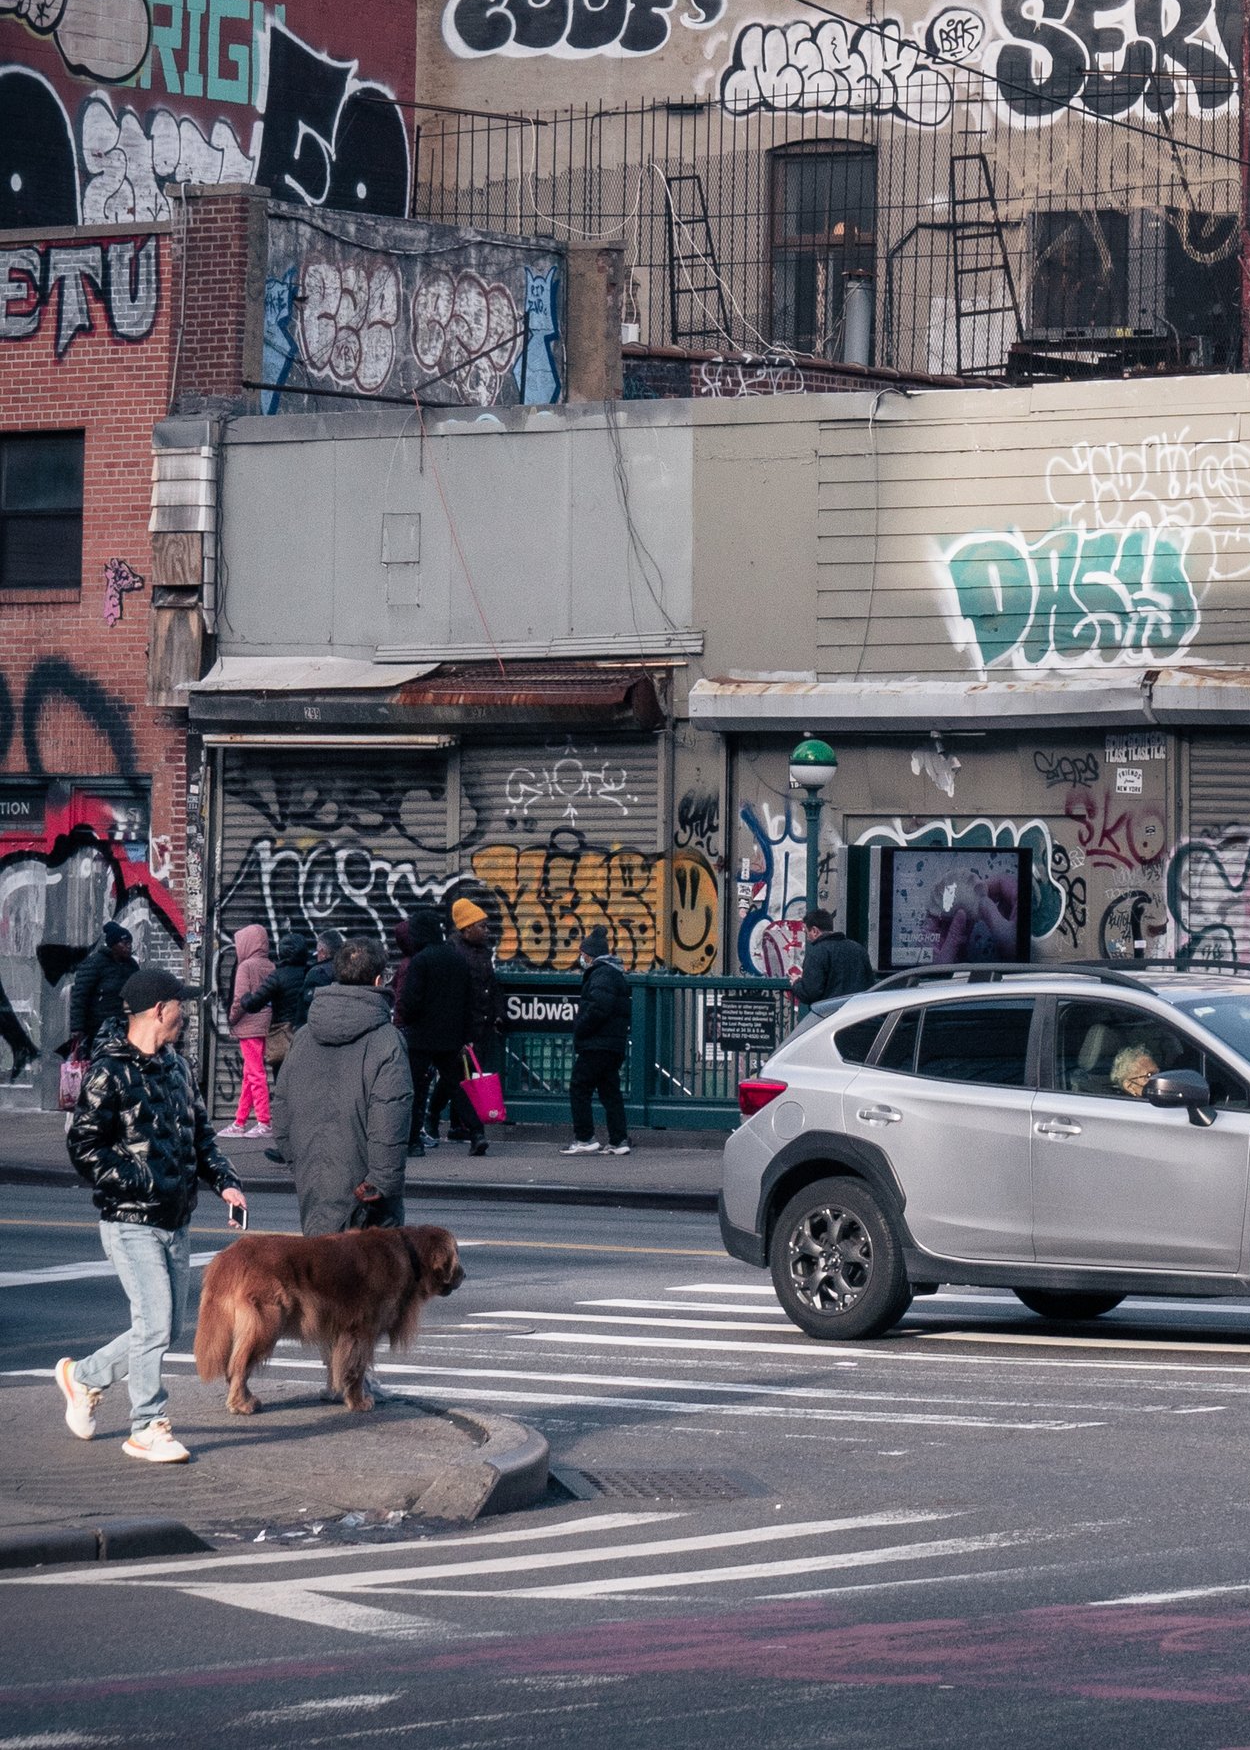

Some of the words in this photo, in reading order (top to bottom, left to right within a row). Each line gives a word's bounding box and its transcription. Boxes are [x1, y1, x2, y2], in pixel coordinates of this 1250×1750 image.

[1119, 769, 1142, 779] FRIENDS
[1117, 784, 1128, 792] NEW
[1128, 785, 1142, 793] YORK
